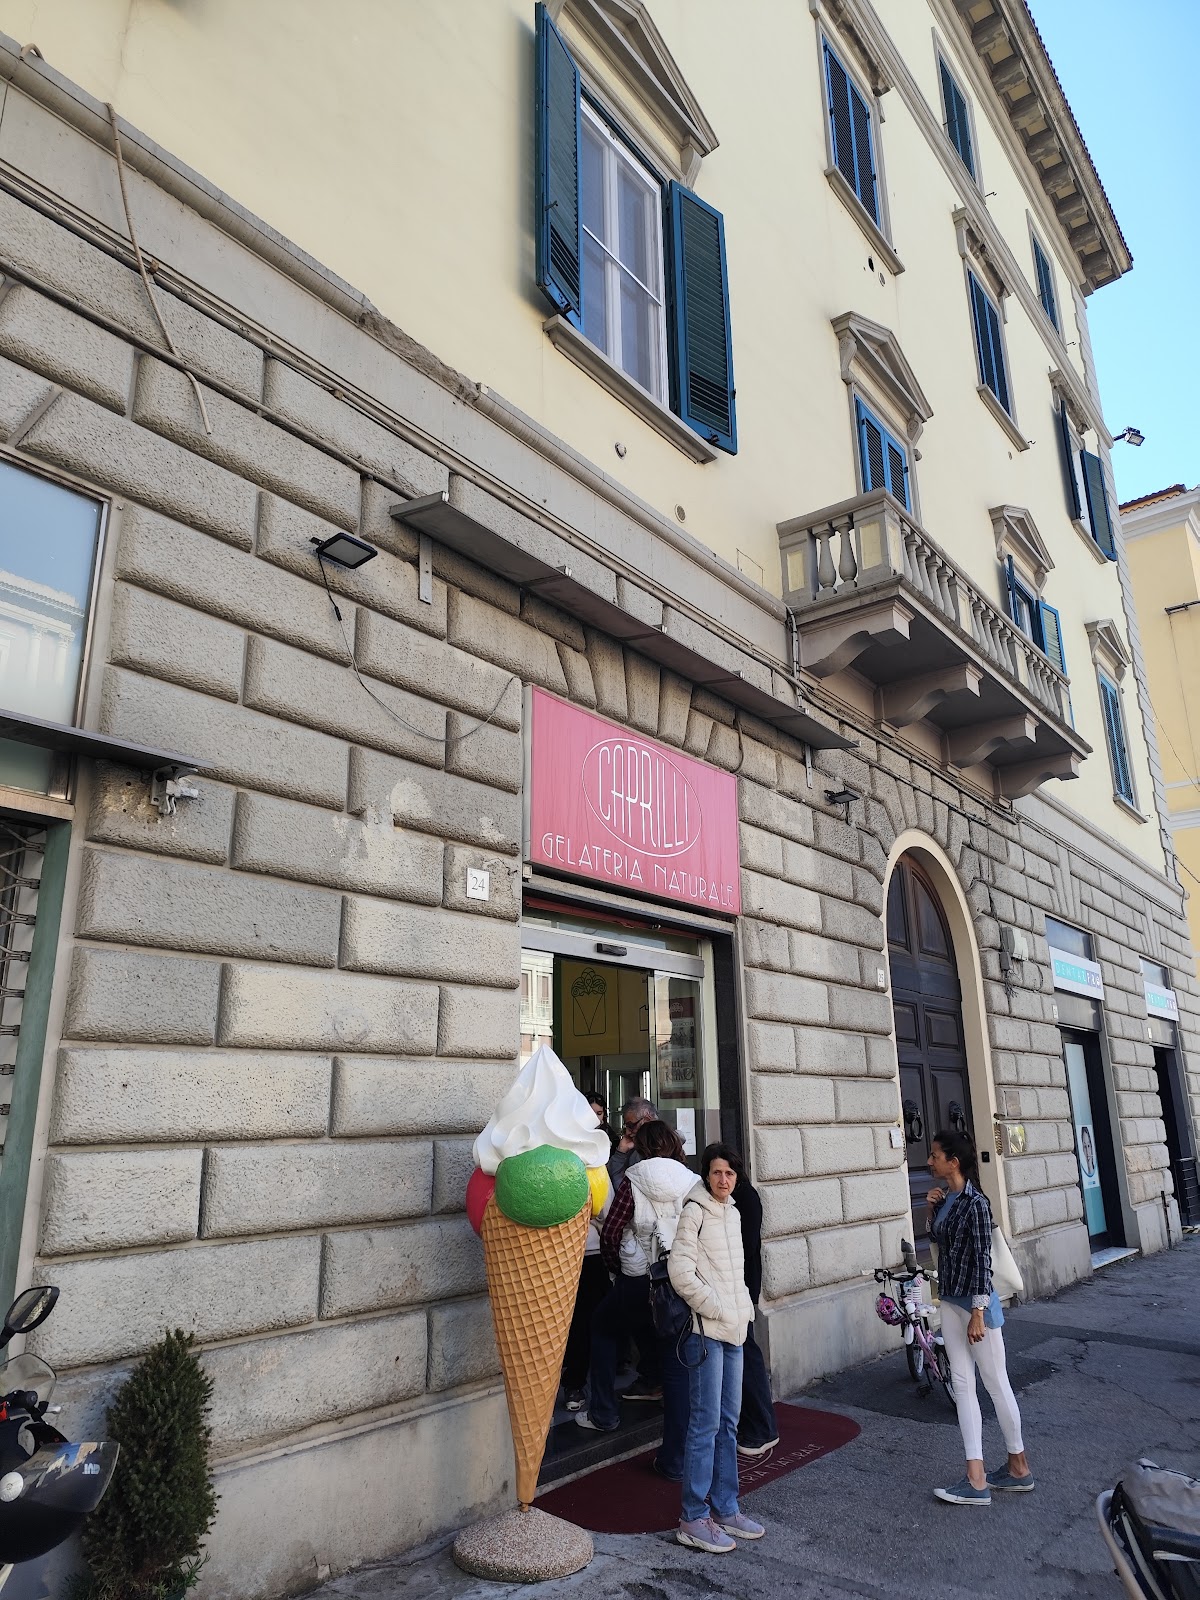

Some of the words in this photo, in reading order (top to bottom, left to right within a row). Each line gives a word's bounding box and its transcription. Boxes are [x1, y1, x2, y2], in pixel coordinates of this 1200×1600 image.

[599, 745, 689, 849] CAPRILLI
[471, 876, 486, 891] 24
[541, 832, 644, 883] GELATERIA
[654, 864, 735, 908] NATURALE
